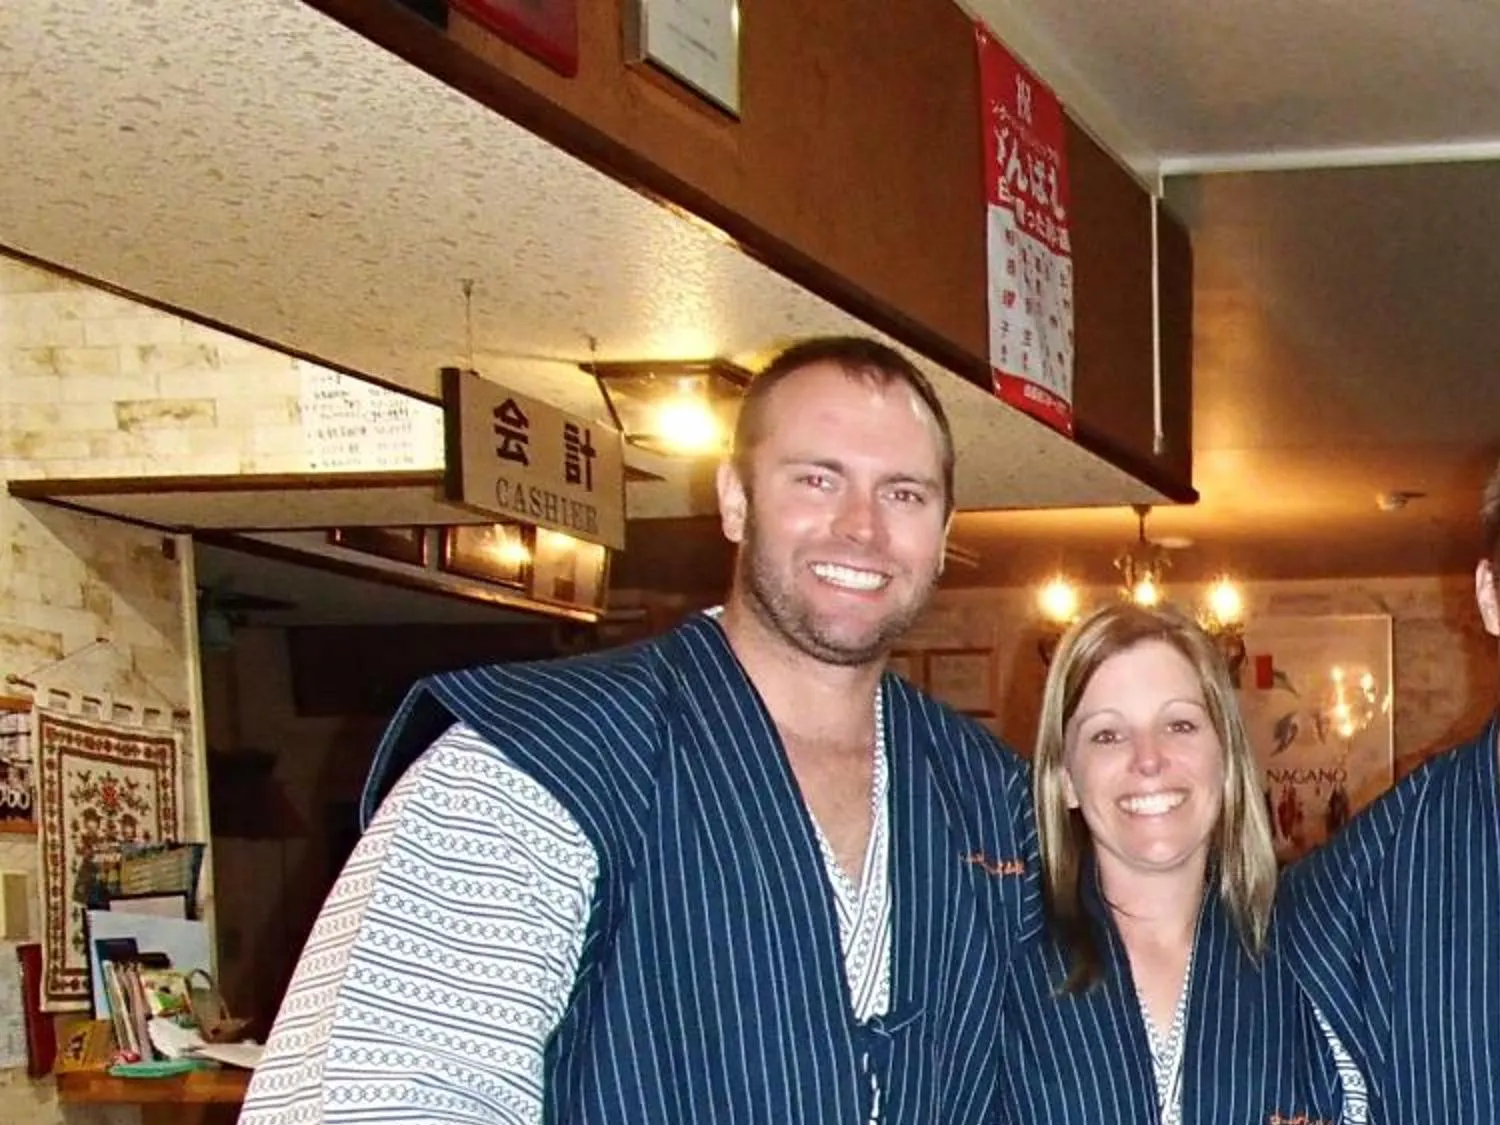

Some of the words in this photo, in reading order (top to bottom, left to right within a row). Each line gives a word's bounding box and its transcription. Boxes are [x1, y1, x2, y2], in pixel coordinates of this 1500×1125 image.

[493, 397, 598, 493] 会計
[495, 477, 599, 535] CASHIER
[1265, 767, 1348, 786] NAGANO
